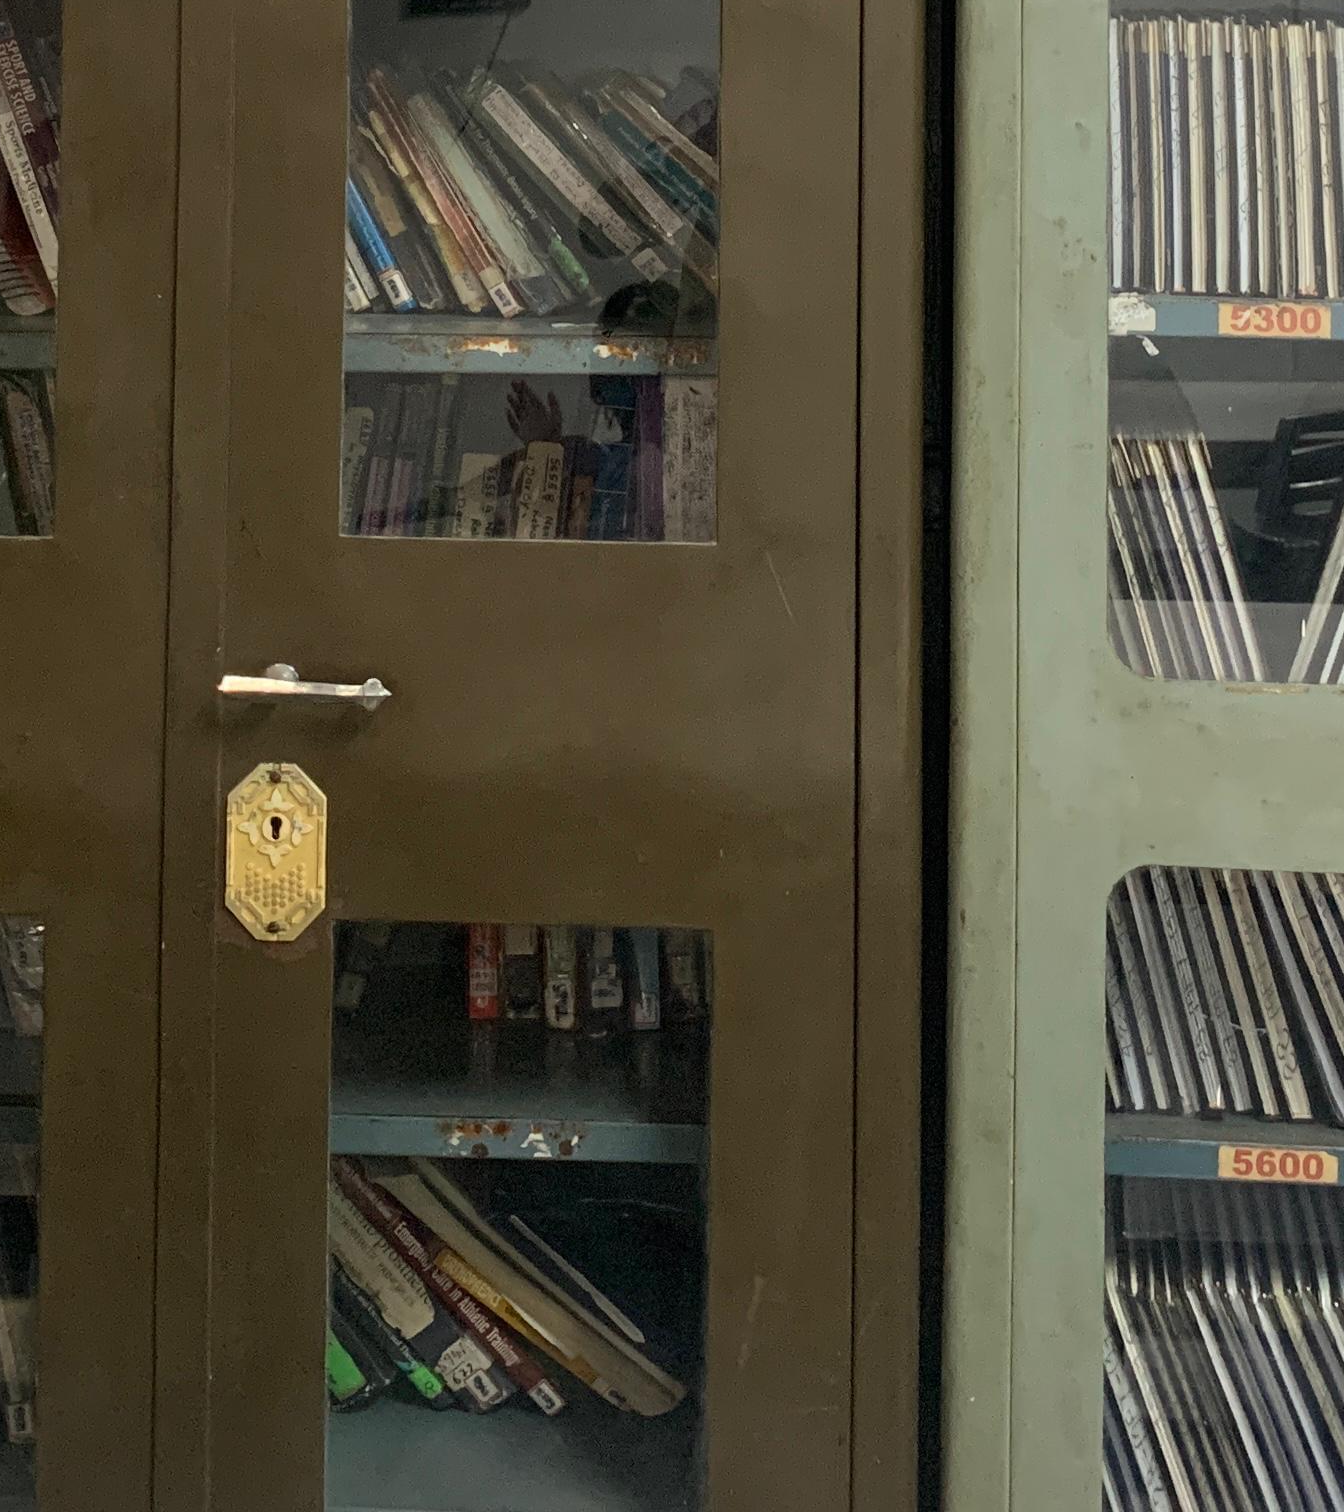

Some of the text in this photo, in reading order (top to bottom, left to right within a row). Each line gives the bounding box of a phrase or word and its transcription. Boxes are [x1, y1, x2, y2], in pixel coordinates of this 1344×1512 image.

[4, 39, 36, 102] SPORT AND
[9, 91, 35, 136] SCIENCE
[2, 119, 26, 159] Sports
[1230, 304, 1322, 334] 5300
[1233, 1149, 1324, 1180] 5600
[456, 1295, 492, 1334] Athletic
[483, 1326, 521, 1368] Training
